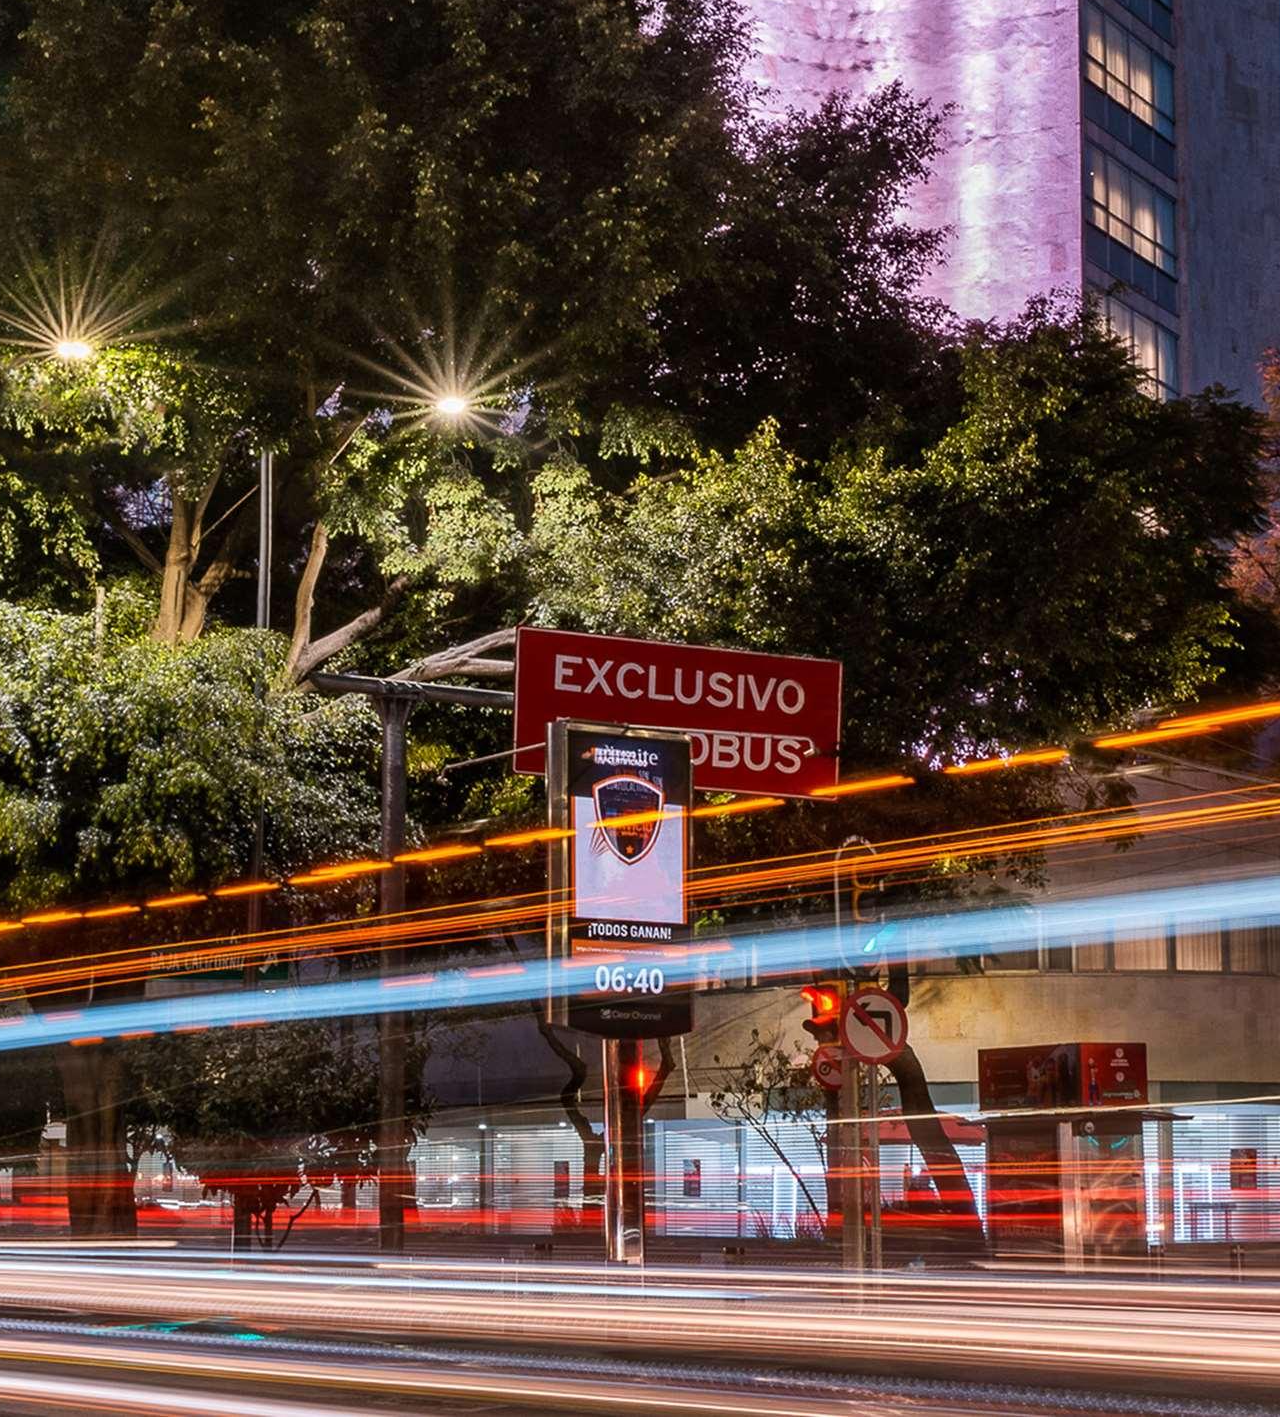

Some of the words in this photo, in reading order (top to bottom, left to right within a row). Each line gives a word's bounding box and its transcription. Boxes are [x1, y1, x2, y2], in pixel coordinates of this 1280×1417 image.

[554, 654, 806, 715] EXCLUSIVO
[689, 732, 801, 774] OBUS
[587, 922, 628, 938] ¡TODOS
[629, 926, 672, 940] GANAN!
[594, 965, 664, 994] 06:40
